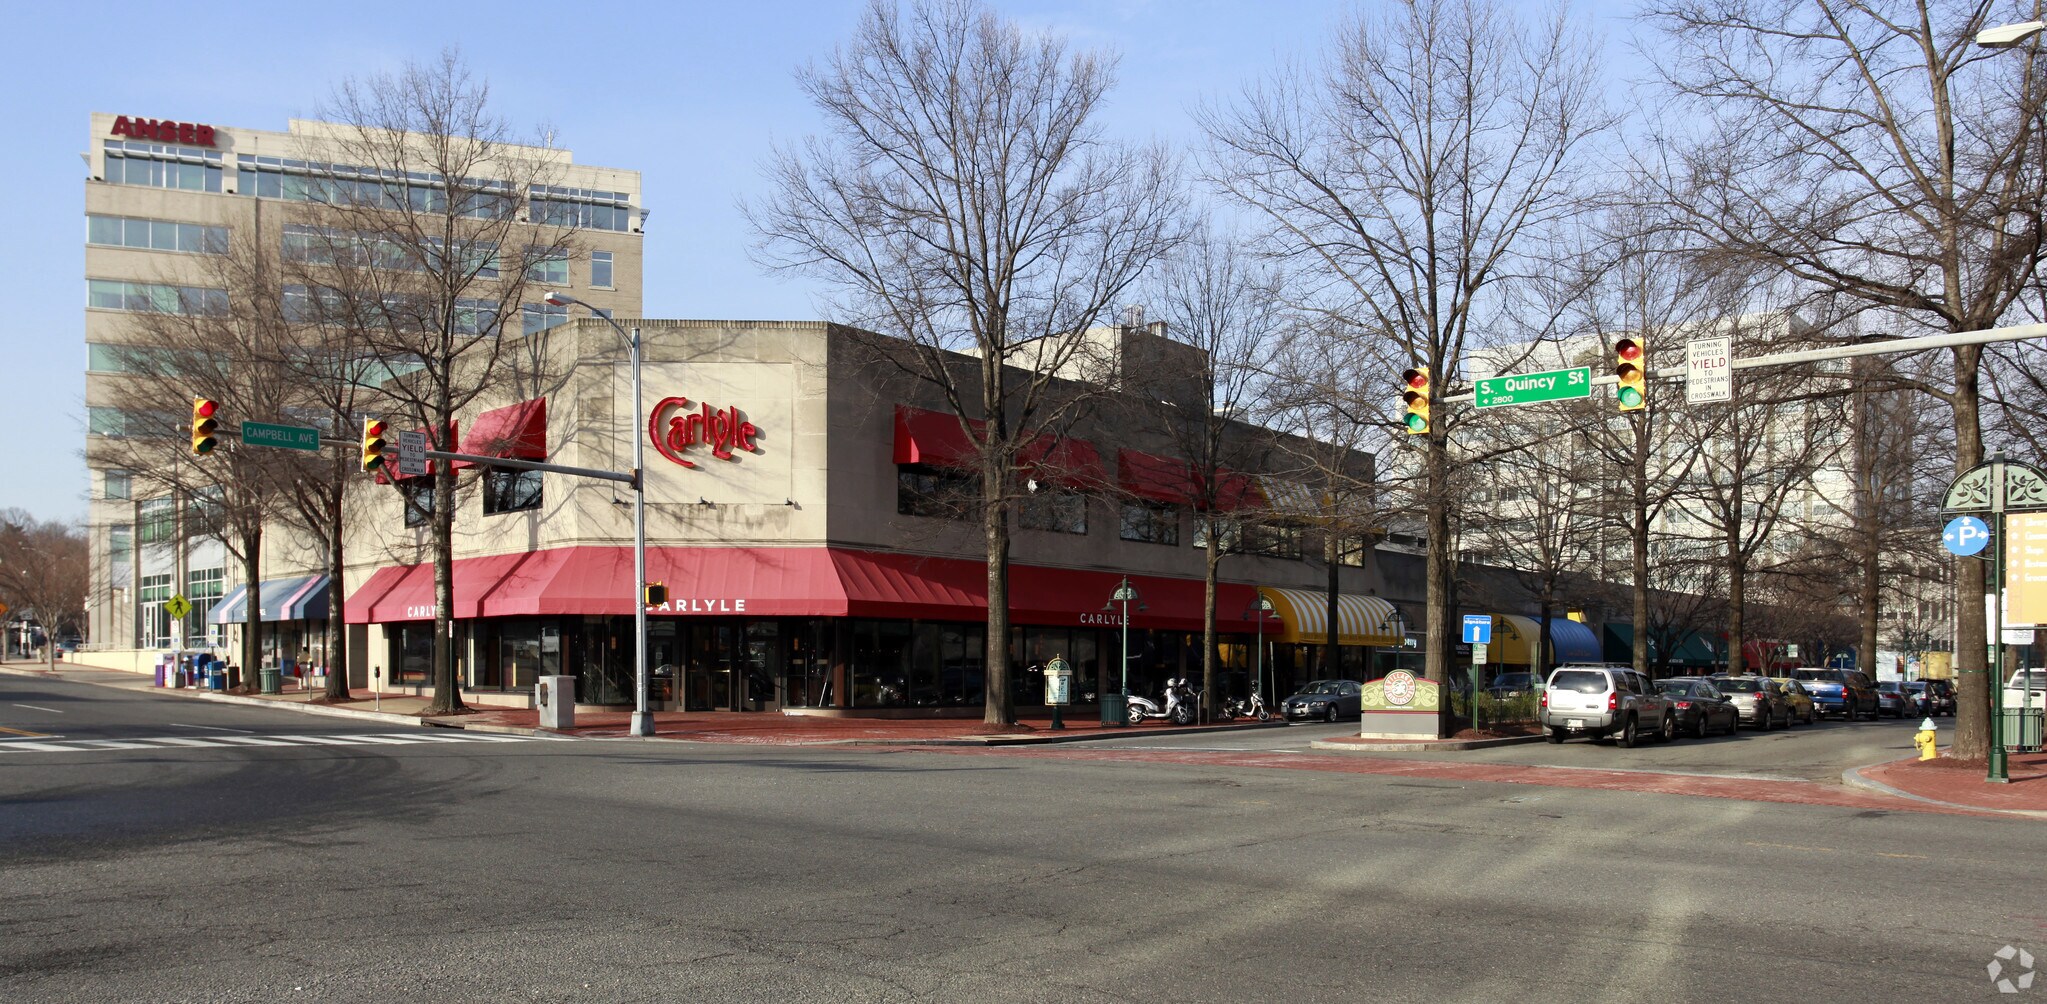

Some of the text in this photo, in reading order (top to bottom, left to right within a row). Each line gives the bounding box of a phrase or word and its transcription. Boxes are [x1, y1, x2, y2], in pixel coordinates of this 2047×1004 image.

[110, 115, 217, 147] ANSER
[1694, 341, 1722, 350] TURNING
[1692, 349, 1724, 358] VEHICLES
[1691, 357, 1727, 370] YIELD
[1704, 369, 1714, 377] TO
[1505, 376, 1556, 392] Quincy
[1567, 371, 1585, 386] St
[1689, 375, 1729, 386] PEDESTRIANS
[1492, 395, 1514, 405] 2800
[1690, 391, 1727, 400] CROSSWALK
[246, 427, 315, 444] CAMPBELL AVE
[648, 396, 756, 469] Carlyle
[402, 444, 424, 453] YIELD
[1959, 526, 1977, 546] P
[407, 605, 436, 617] CARLY
